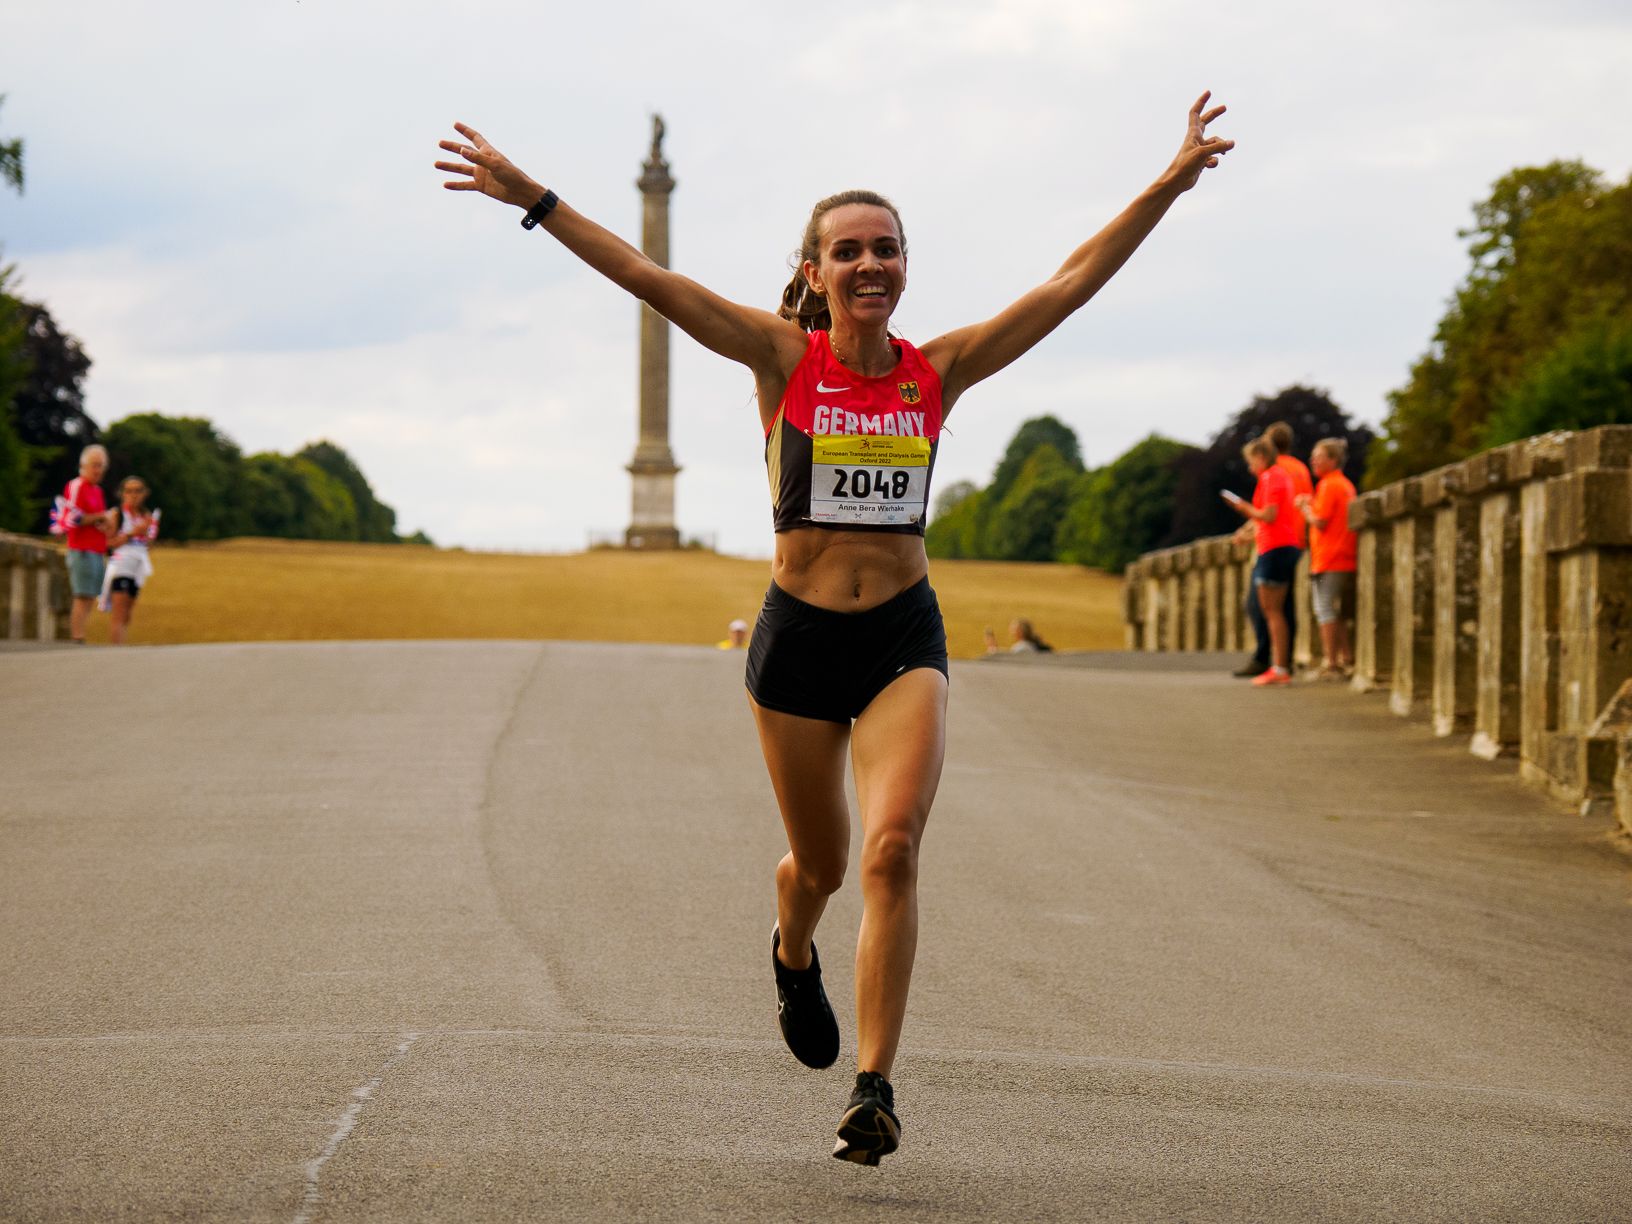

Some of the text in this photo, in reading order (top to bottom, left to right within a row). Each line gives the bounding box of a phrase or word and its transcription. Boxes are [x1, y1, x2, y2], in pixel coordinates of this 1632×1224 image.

[813, 405, 925, 437] GERMANY
[832, 469, 909, 499] 2048
[859, 504, 876, 512] Bera
